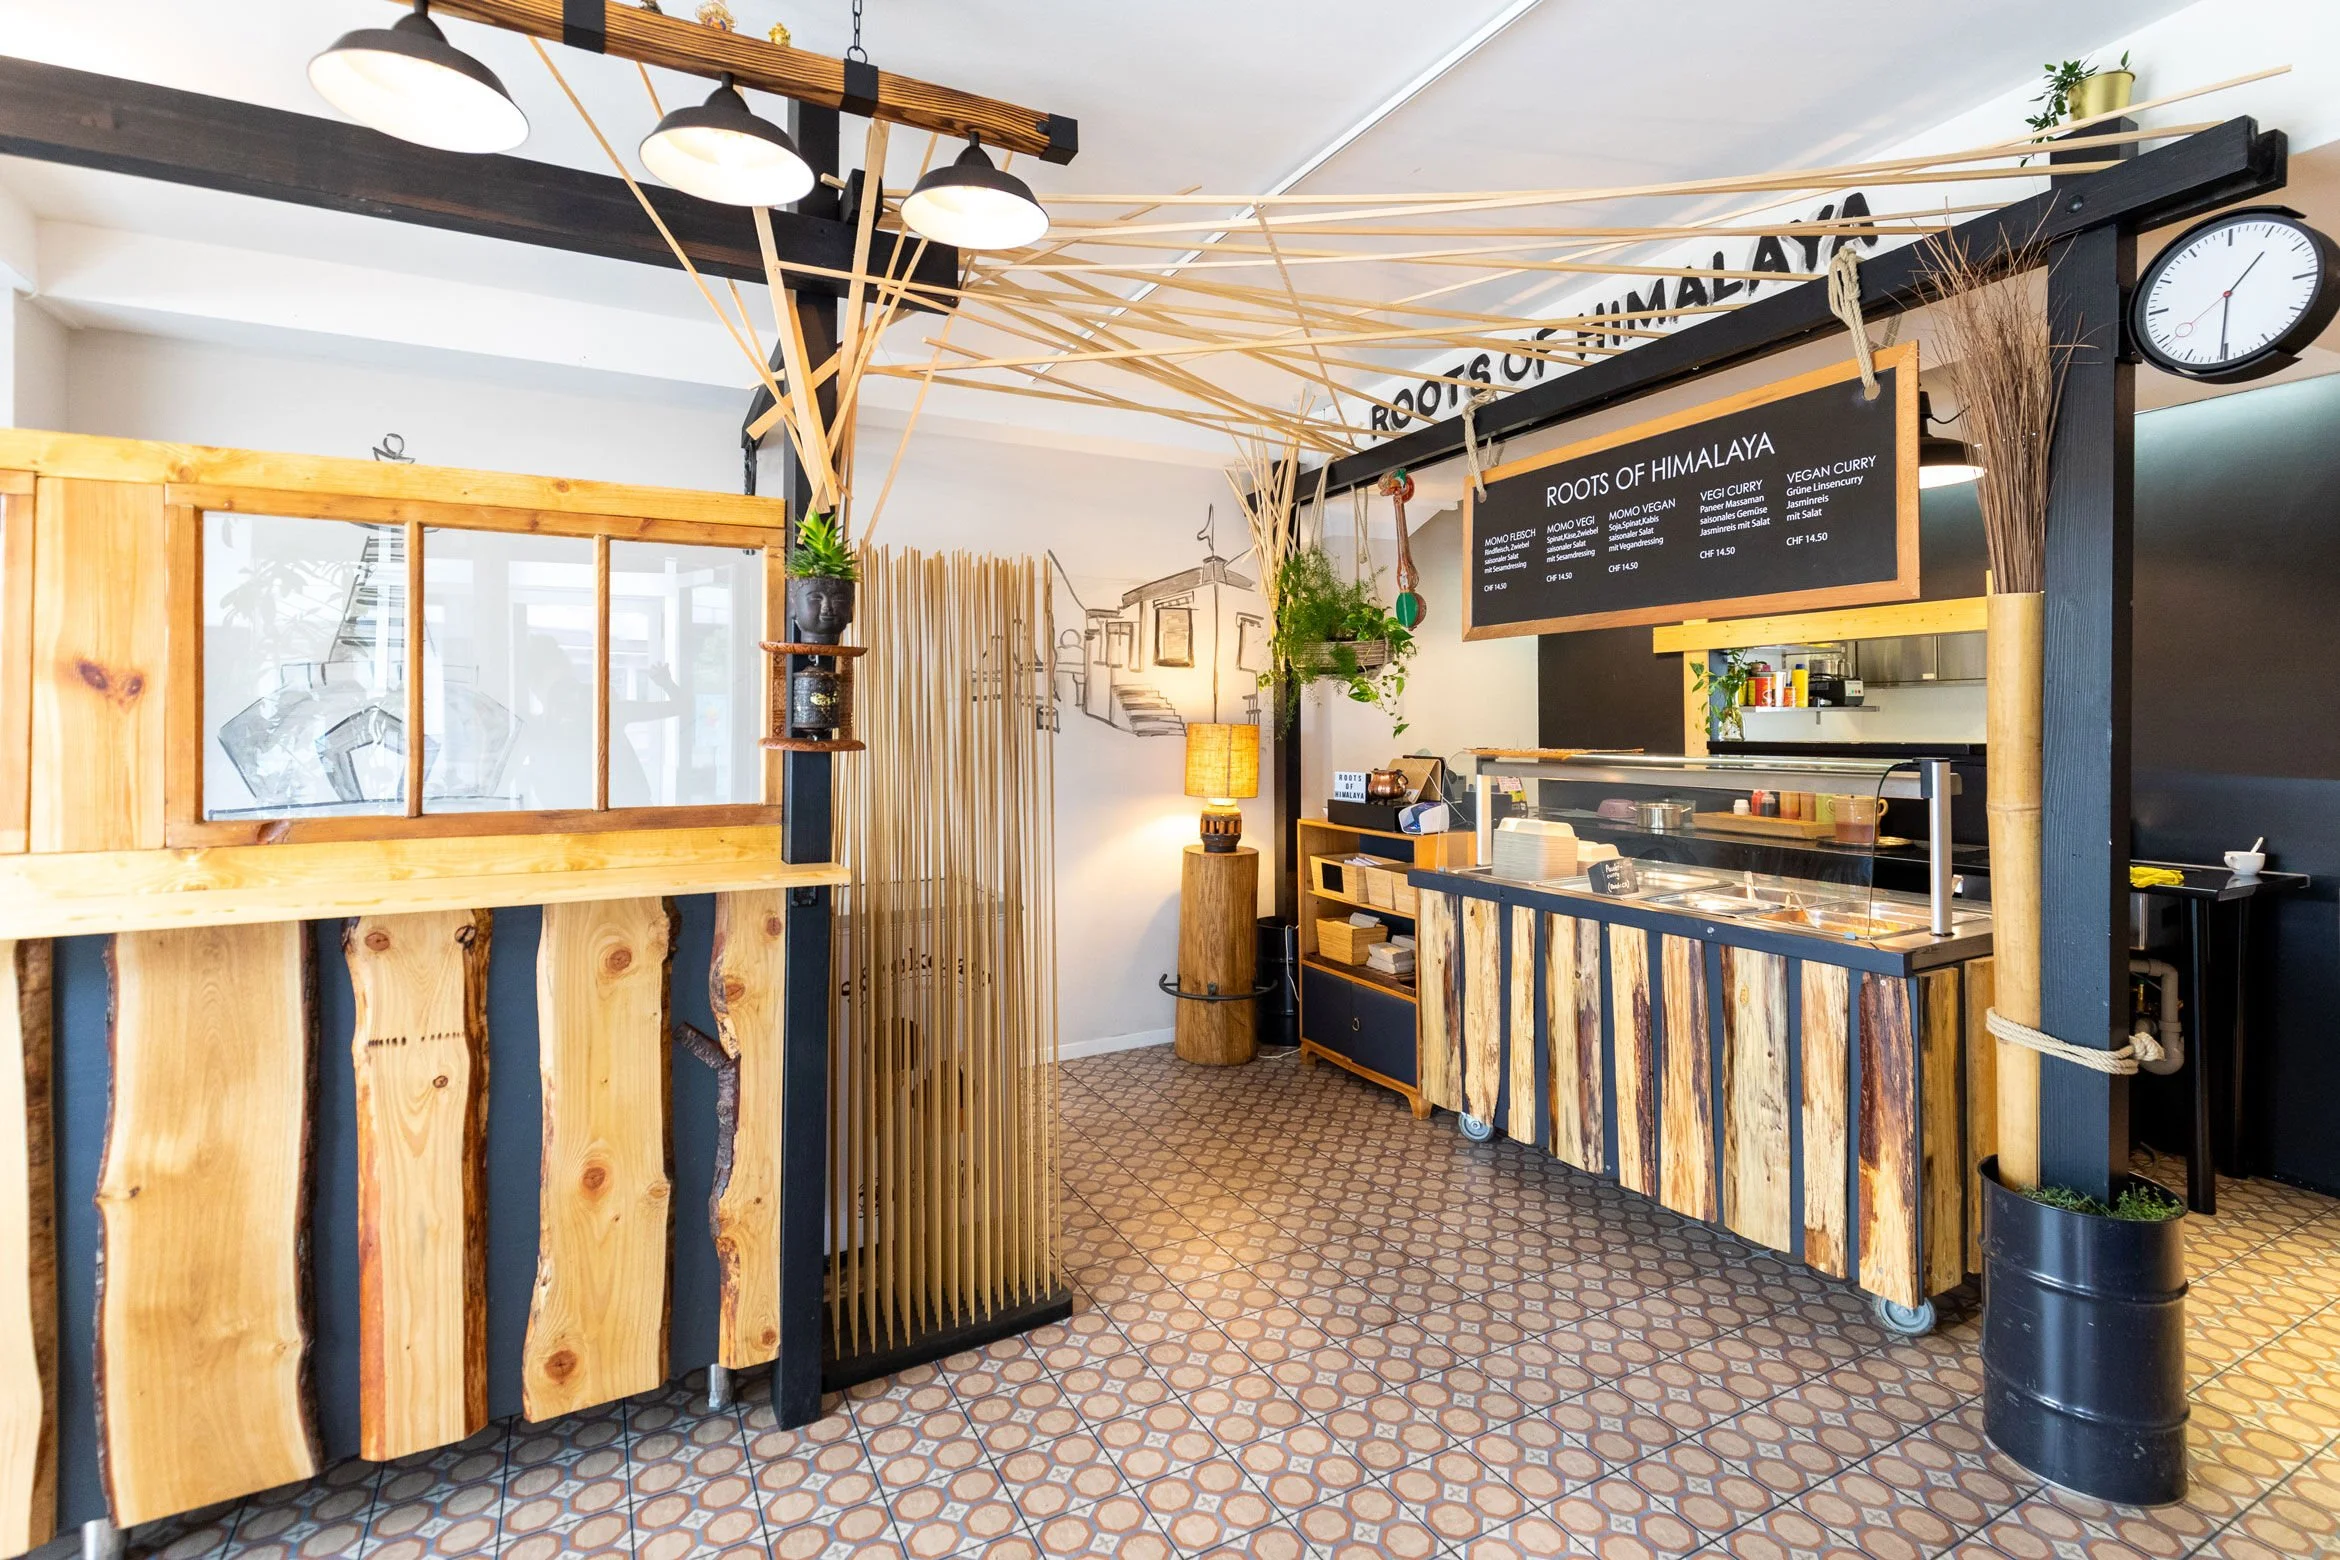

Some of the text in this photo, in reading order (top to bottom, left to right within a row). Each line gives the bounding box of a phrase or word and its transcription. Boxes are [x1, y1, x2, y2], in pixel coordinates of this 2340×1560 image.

[1371, 192, 1878, 441] ROOTS OF HIMALAYA
[1546, 431, 1775, 507] ROOTS OF HIMALAYA
[1786, 455, 1877, 483] VEGAN CURRY
[1700, 479, 1763, 501] VEGI CURRY
[1786, 475, 1864, 497] Grüne Linsencurry
[1608, 498, 1676, 520] MOMO VEGAN
[1700, 495, 1765, 514] Paneer Massaman
[1786, 494, 1829, 510] Jasminreis
[1700, 506, 1768, 525] saisonales Gemüse
[1786, 508, 1822, 521] mit Salat
[1547, 515, 1595, 534] MOMO VEGI
[1699, 517, 1771, 537] Jasminreis mit Salat
[1485, 528, 1536, 546] MOMO FLEISCH
[1608, 527, 1654, 542] saisonaler Salat
[1786, 532, 1828, 546] CHF 14.50
[1511, 541, 1529, 551] Zwiebel
[1546, 540, 1586, 553] saisonaler Salat
[1608, 537, 1664, 552] mit Vegandressing
[1485, 553, 1519, 565] saisonaler Salat
[1546, 549, 1595, 563] mit Sesamdressing
[1699, 546, 1736, 559] CHF 14.50
[1484, 561, 1527, 574] mit Sesamdressing
[1608, 561, 1639, 573] CHF 14.50
[1546, 572, 1573, 583] CHF 14.50
[1484, 582, 1507, 592] CHF 14.50
[1338, 774, 1362, 782] ROOTS
[1335, 791, 1364, 800] HIMALAYA
